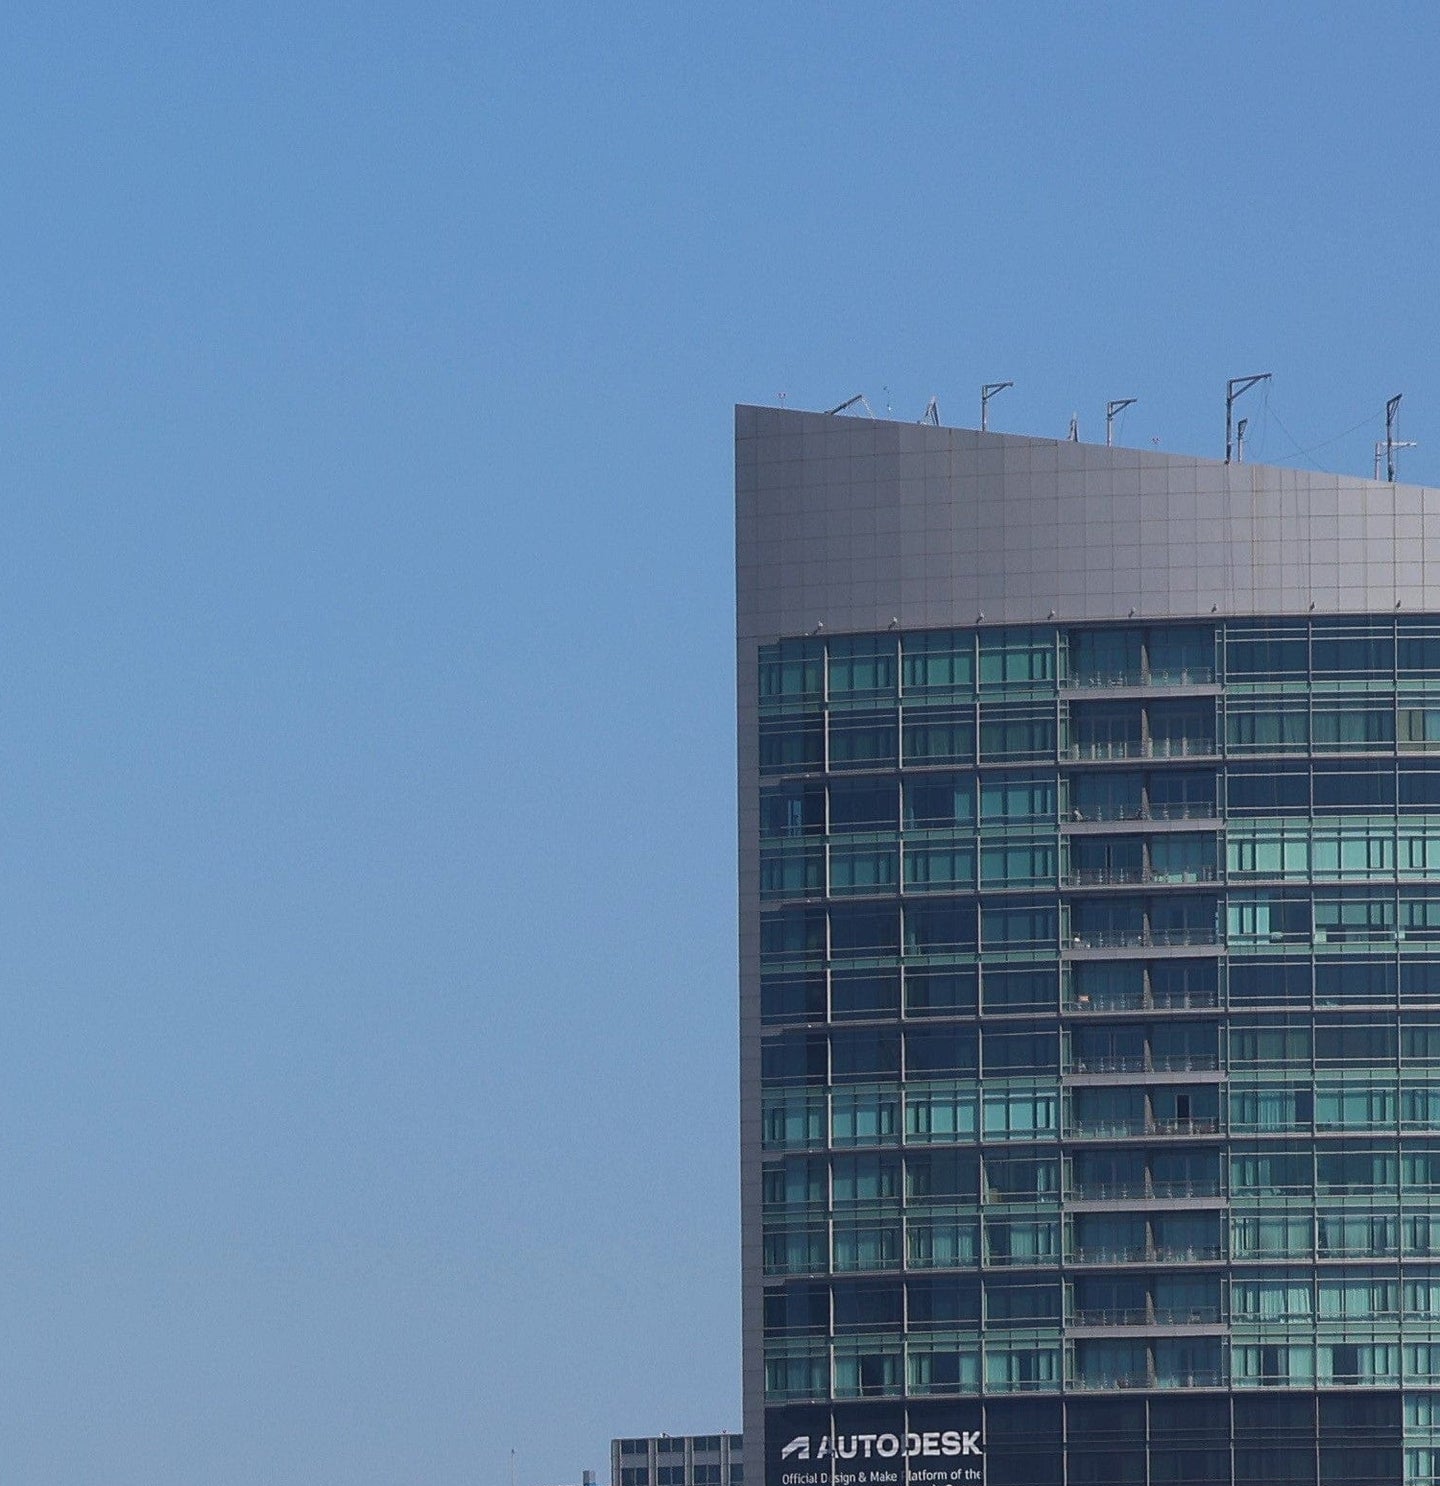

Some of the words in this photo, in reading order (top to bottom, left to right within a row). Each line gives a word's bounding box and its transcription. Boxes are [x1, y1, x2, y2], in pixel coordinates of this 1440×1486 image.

[817, 1431, 982, 1459] AUTODESK
[782, 1472, 817, 1485] Official
[821, 1472, 856, 1486] Dsign
[858, 1471, 866, 1483] &
[870, 1470, 897, 1482] Make
[901, 1469, 947, 1482] latform
[950, 1468, 962, 1480] of
[965, 1468, 981, 1480] the
